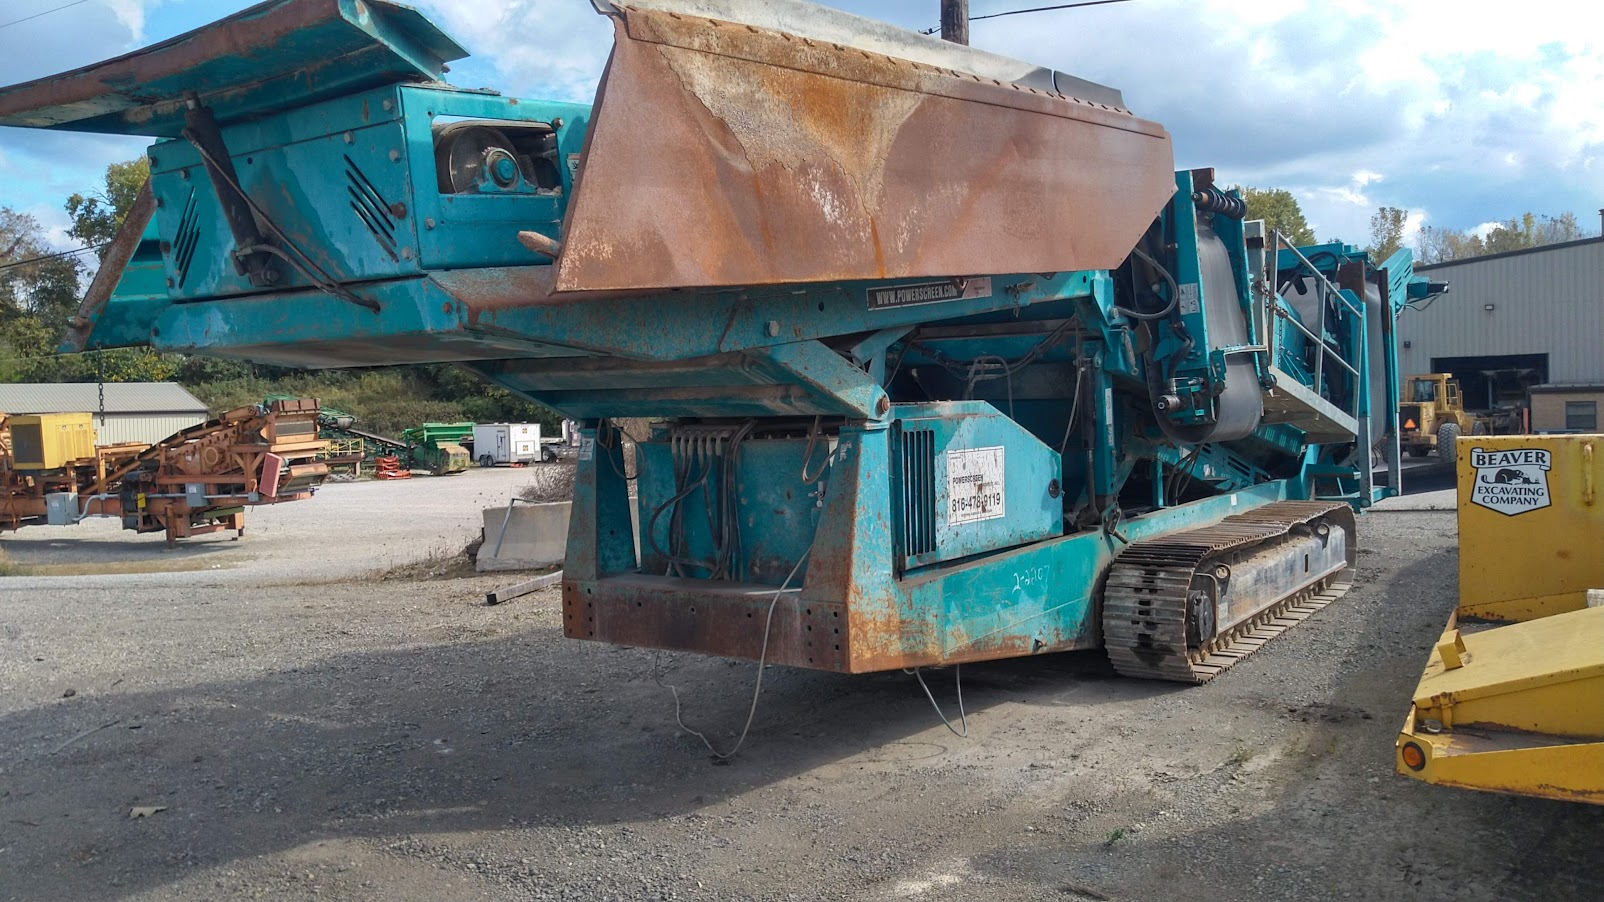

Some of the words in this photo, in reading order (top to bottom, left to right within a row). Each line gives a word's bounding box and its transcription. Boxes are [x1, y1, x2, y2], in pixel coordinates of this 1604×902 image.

[1476, 451, 1546, 466] BEAVER
[1477, 486, 1544, 496] EXCAVATING
[952, 492, 1001, 513] 816-478-9119
[1482, 495, 1539, 506] COMPANY
